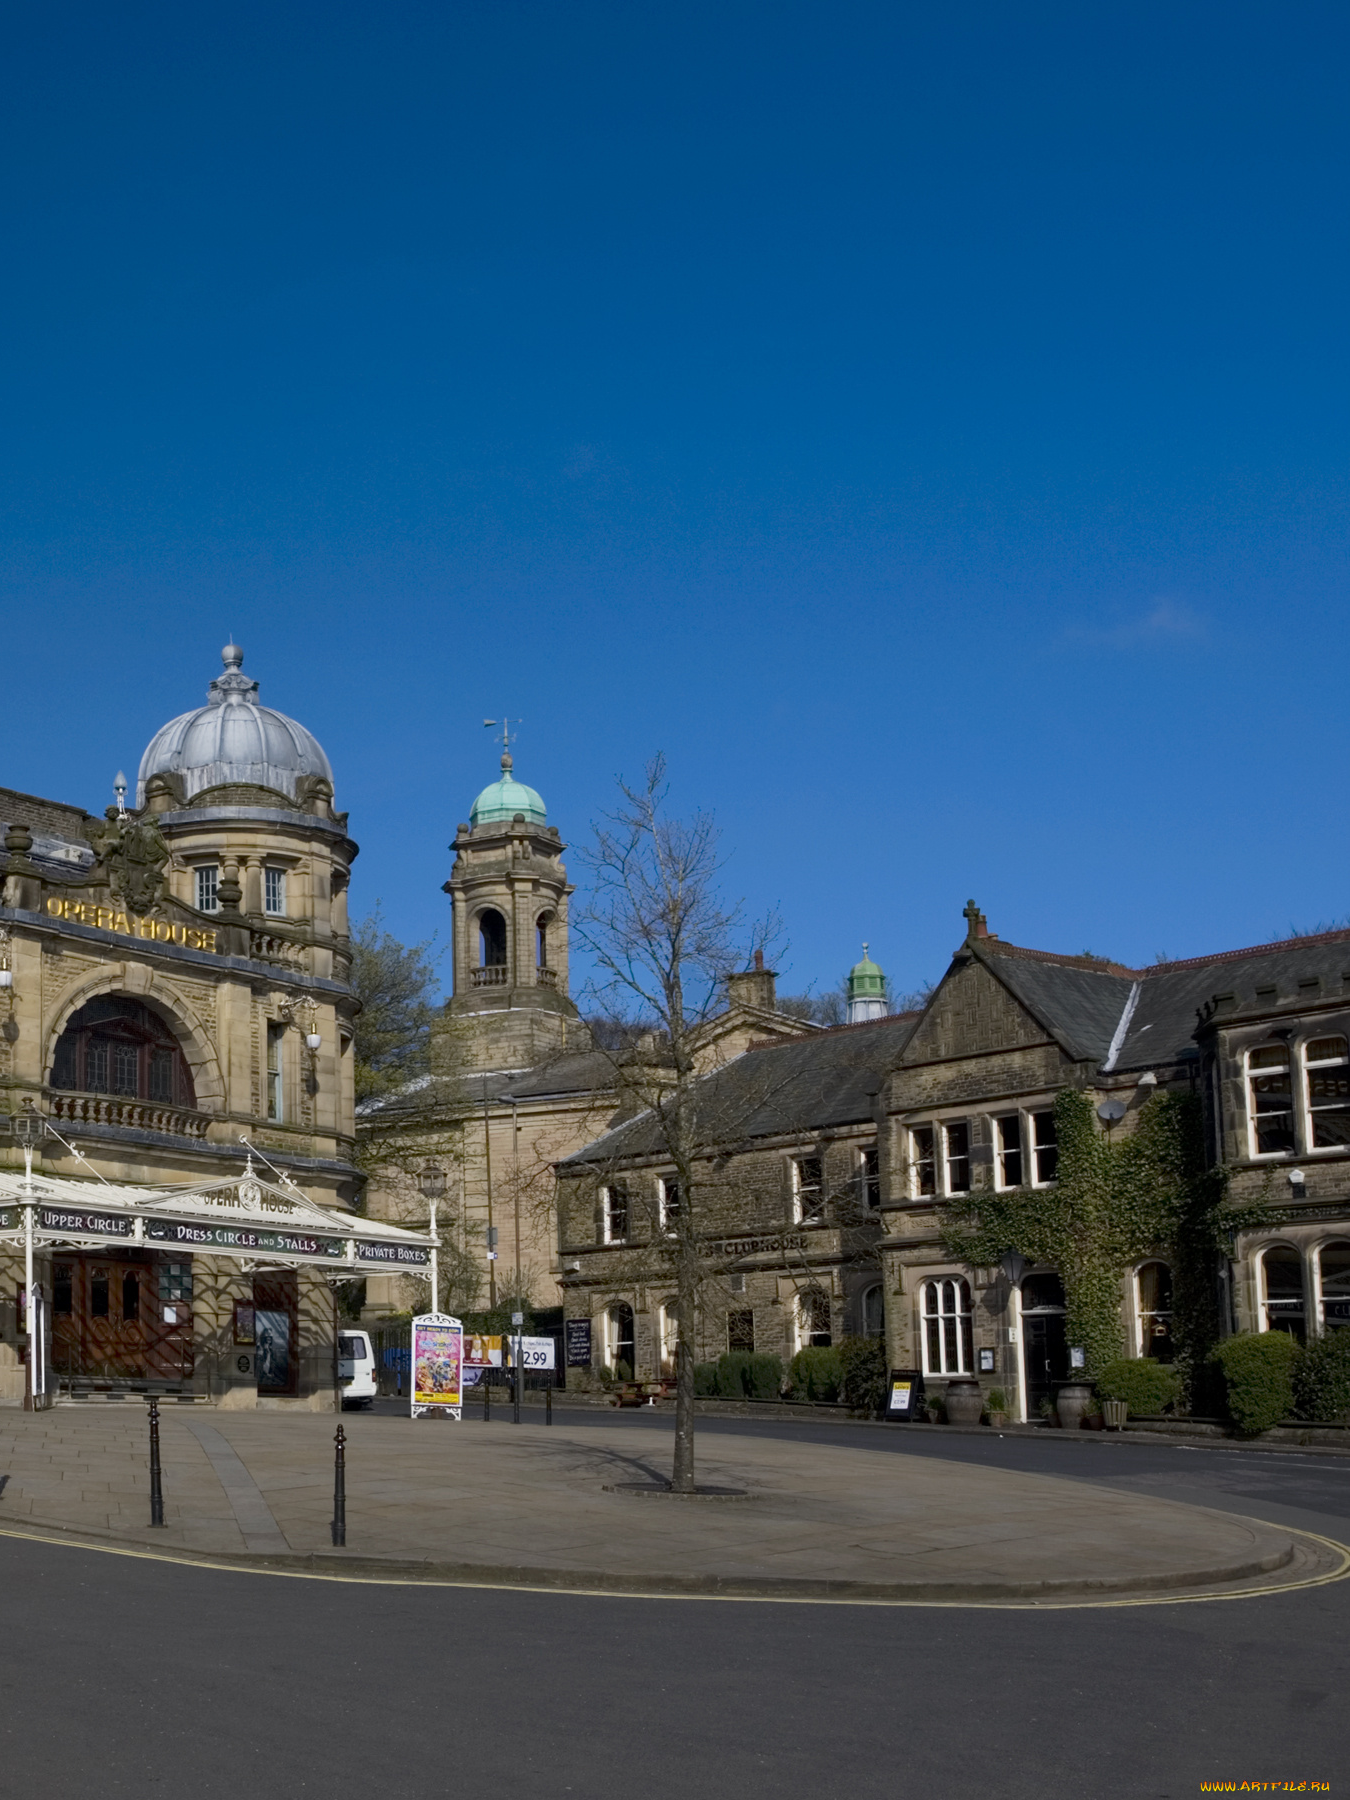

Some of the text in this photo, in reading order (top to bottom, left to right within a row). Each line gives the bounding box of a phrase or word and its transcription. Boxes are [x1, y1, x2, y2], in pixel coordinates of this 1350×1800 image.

[47, 897, 217, 953] OPERA HOUSE
[203, 1186, 295, 1214] OPERA HOUSE
[44, 1211, 126, 1232] UPPER CIRCLE
[177, 1225, 317, 1251] DRESS CIRCLE AND STALLS
[358, 1244, 426, 1262] PRIVATE BOXES
